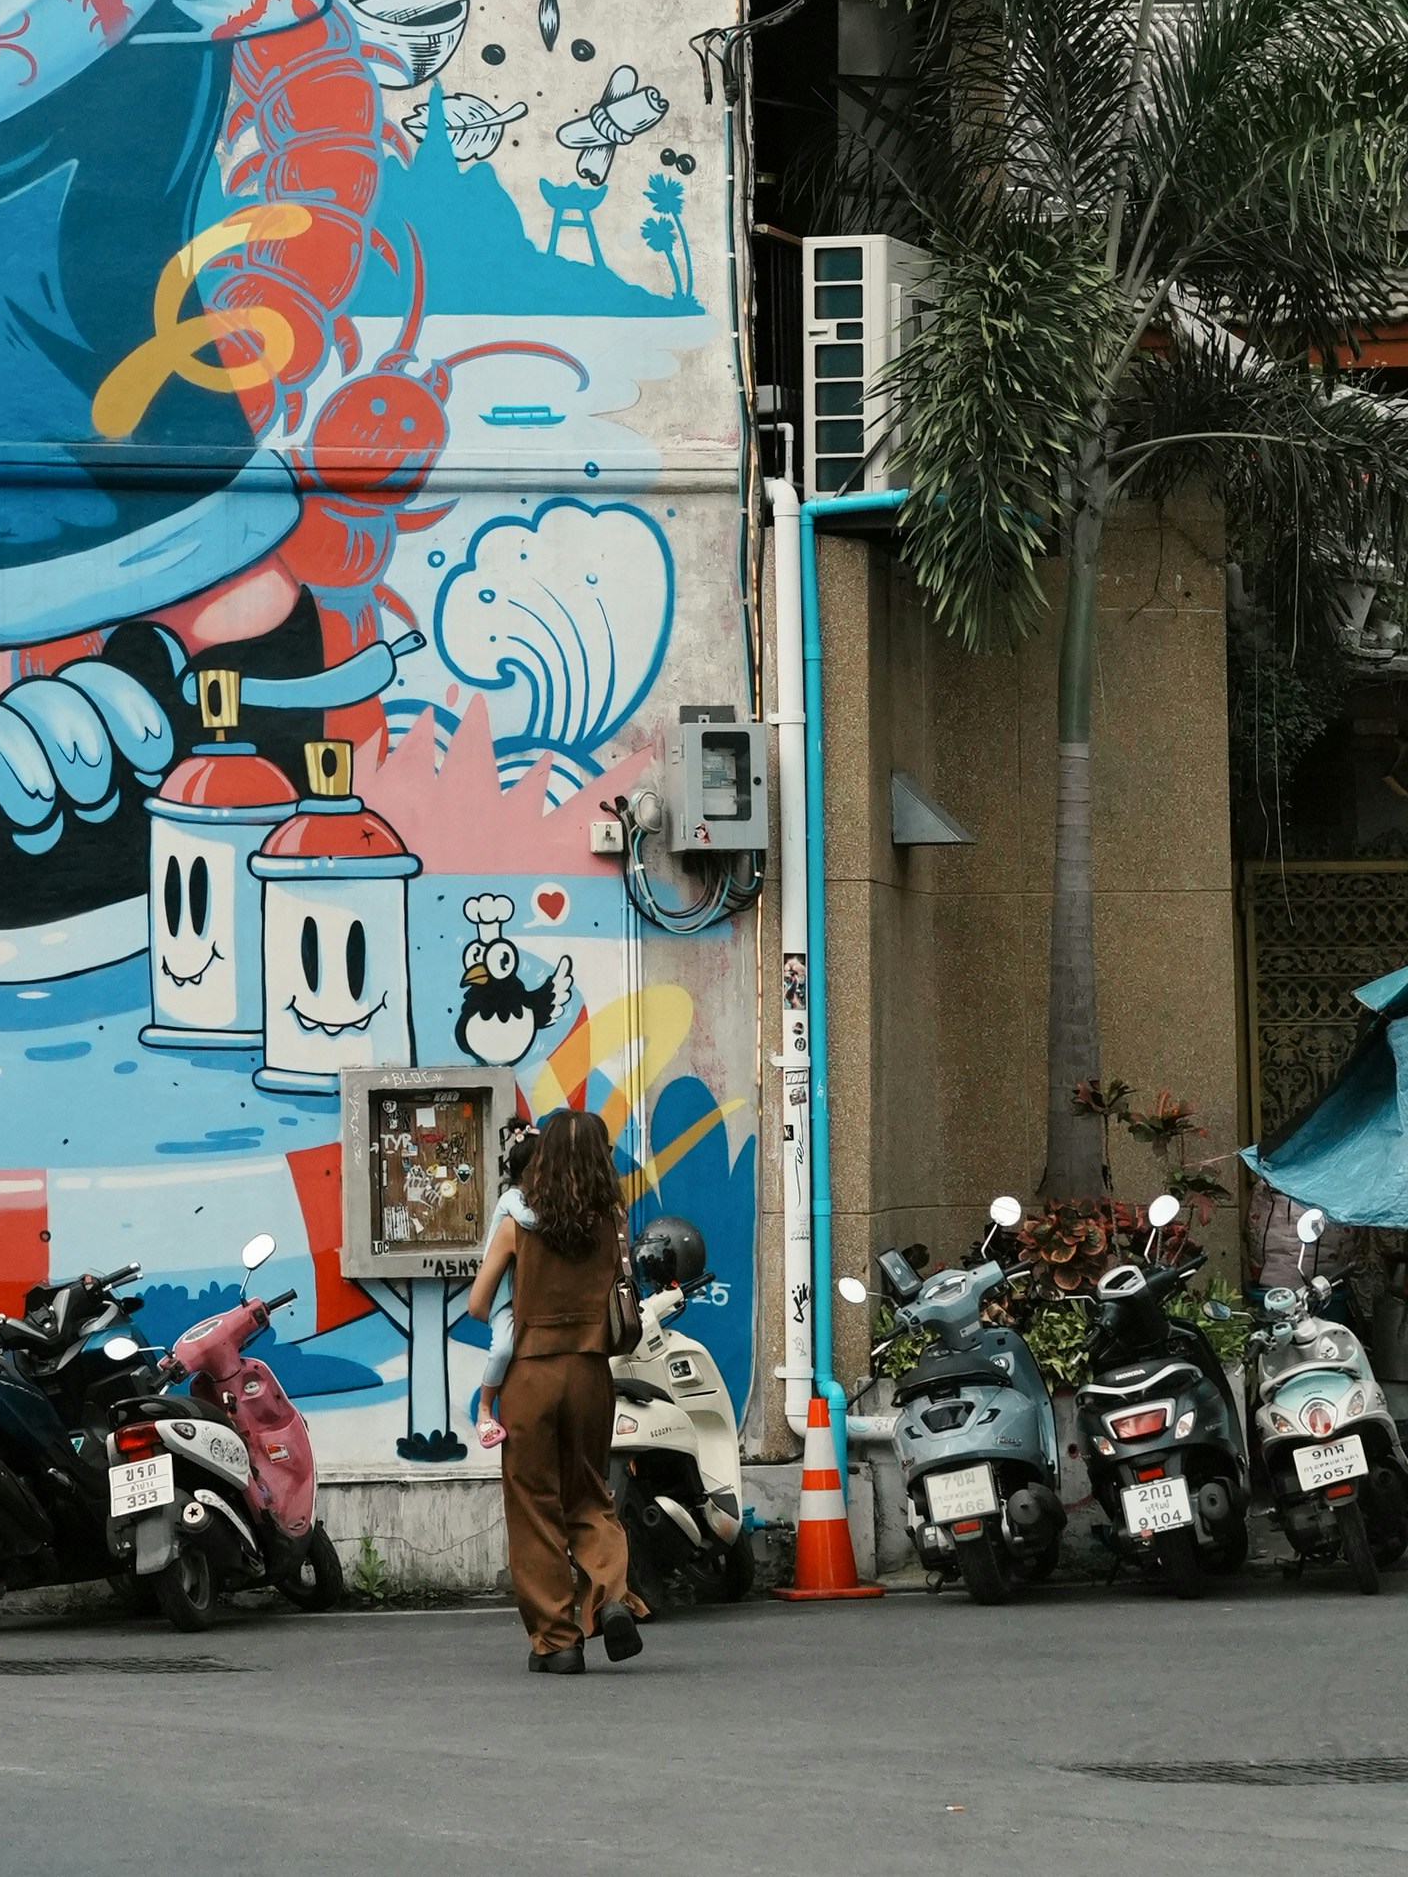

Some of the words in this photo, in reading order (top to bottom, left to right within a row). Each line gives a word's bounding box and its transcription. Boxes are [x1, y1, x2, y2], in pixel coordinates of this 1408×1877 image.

[1115, 1368, 1147, 1381] HONDA
[1312, 1464, 1355, 1484] 2057
[126, 1490, 159, 1509] 333
[942, 1498, 987, 1518] 7466
[1138, 1509, 1182, 1530] 9104
